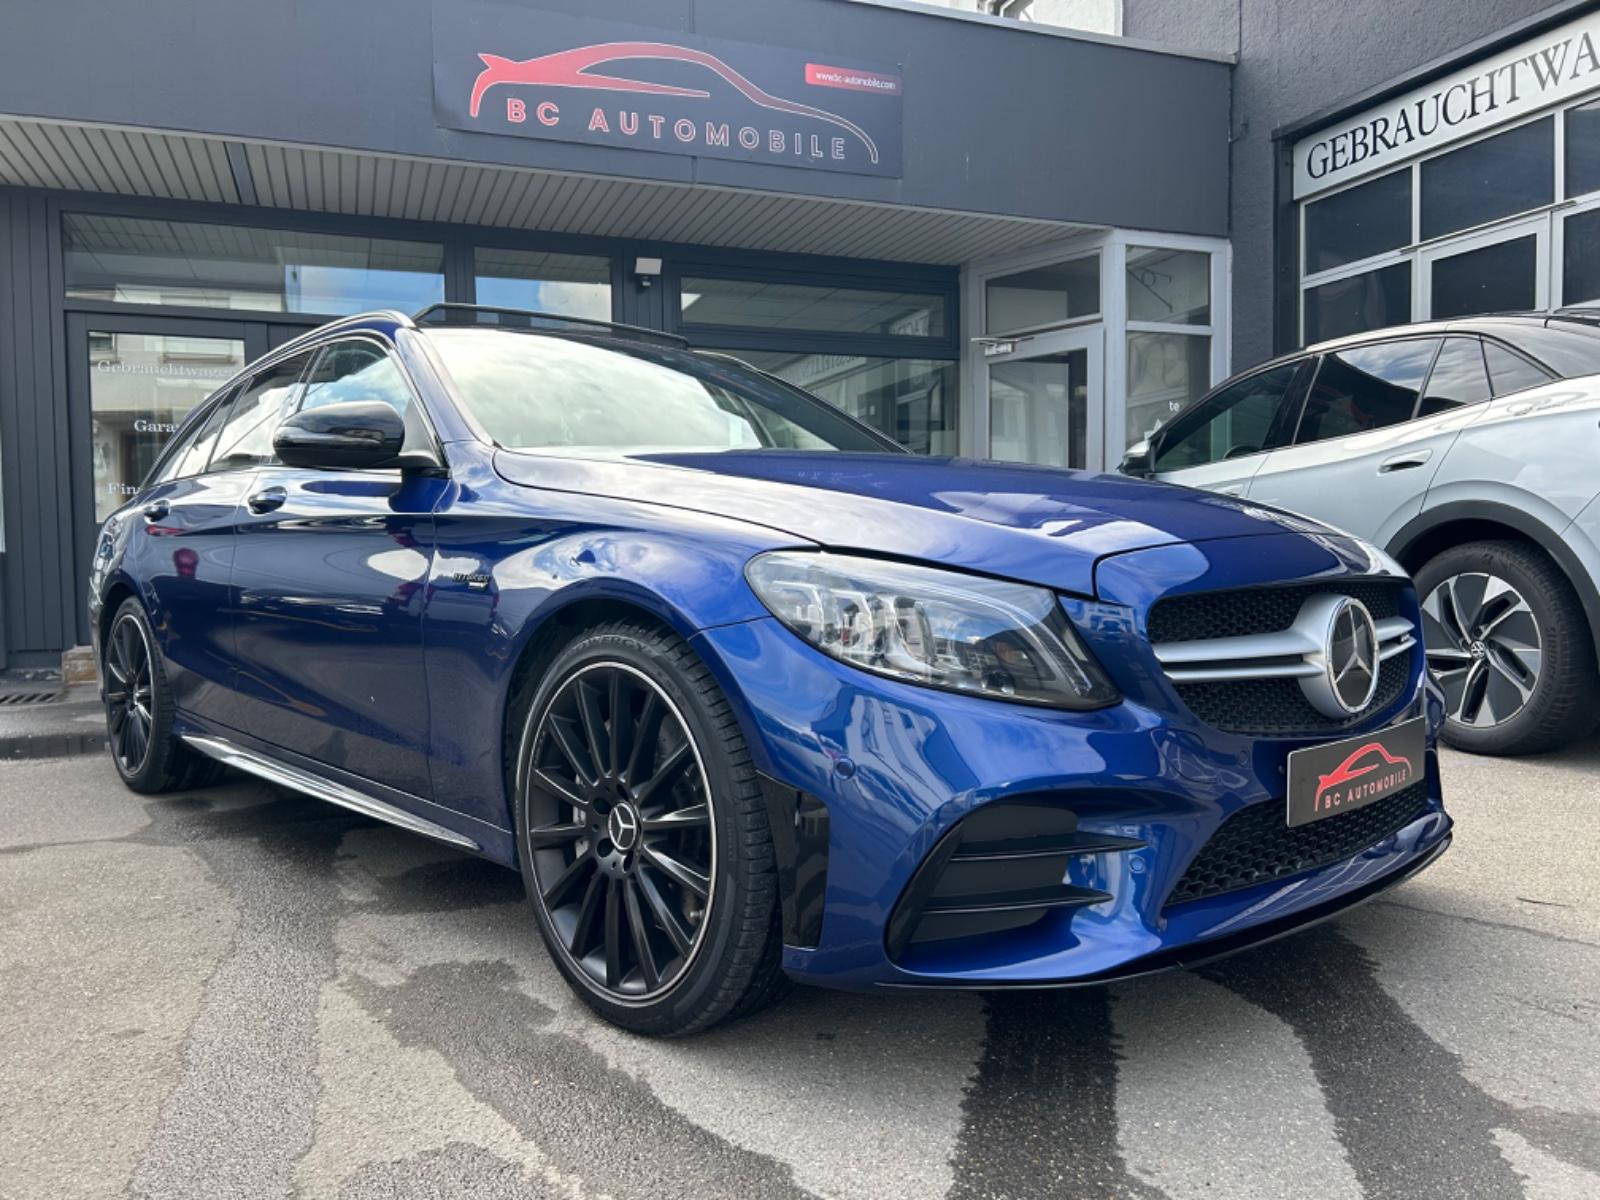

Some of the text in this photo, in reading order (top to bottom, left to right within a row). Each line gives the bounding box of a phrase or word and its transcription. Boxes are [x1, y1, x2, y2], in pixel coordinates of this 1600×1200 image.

[507, 97, 846, 160] BC AUTOMOBILE
[1306, 31, 1600, 179] GEBRAUCHTWA
[1324, 768, 1407, 809] BC AUTOMOBILE
